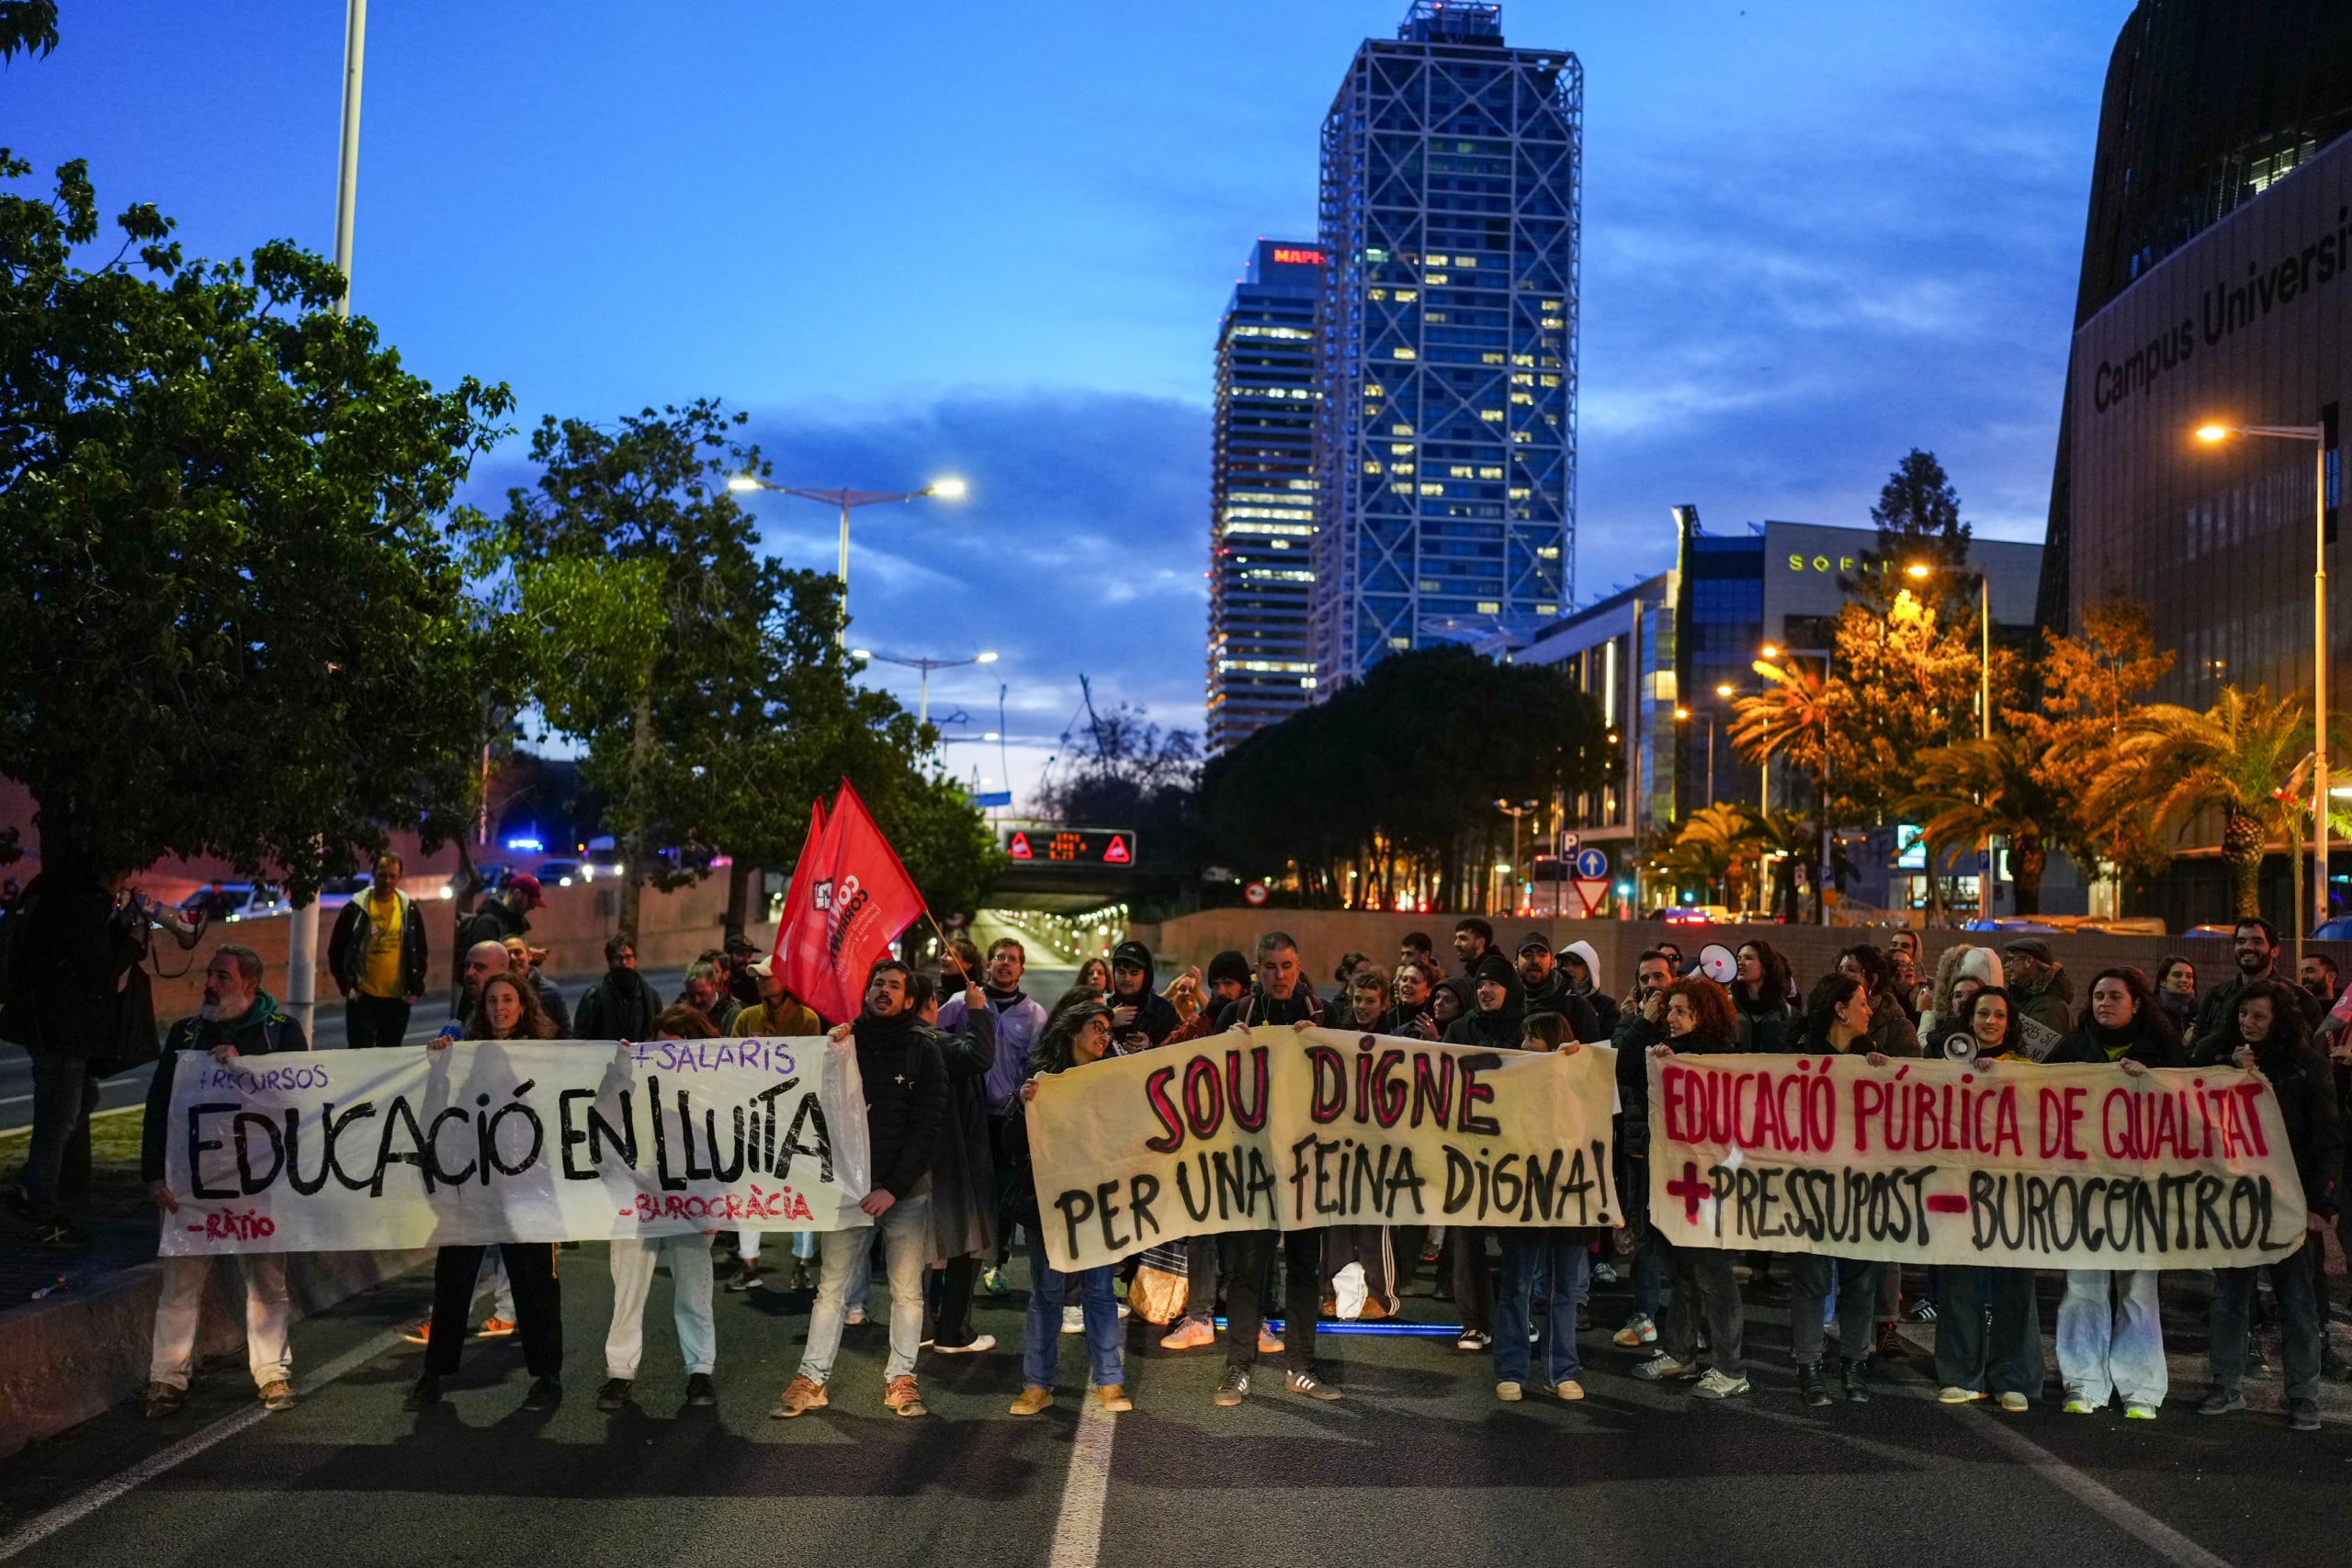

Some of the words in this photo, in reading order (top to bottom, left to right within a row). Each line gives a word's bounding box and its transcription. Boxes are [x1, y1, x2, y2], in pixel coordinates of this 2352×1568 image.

[2094, 318, 2194, 413] Campus
[2203, 206, 2352, 346] Universi
[1564, 833, 1577, 852] P
[189, 1077, 545, 1199] EDUCACIÓ
[560, 1089, 638, 1179] EN
[648, 1076, 834, 1191] LLUITA
[1146, 1045, 1270, 1154] SOU
[1306, 1034, 1503, 1135] DIGNE
[1662, 1057, 1836, 1152] EDUCACIÓ
[1853, 1066, 2022, 1156] PÚBLICA
[2038, 1088, 2087, 1160] DE
[2102, 1077, 2270, 1159] QUALITAT
[1054, 1173, 1160, 1259] PER
[1177, 1145, 1275, 1223] UNA
[1289, 1133, 1425, 1221] FEINA
[1441, 1139, 1610, 1225] DIGNA!
